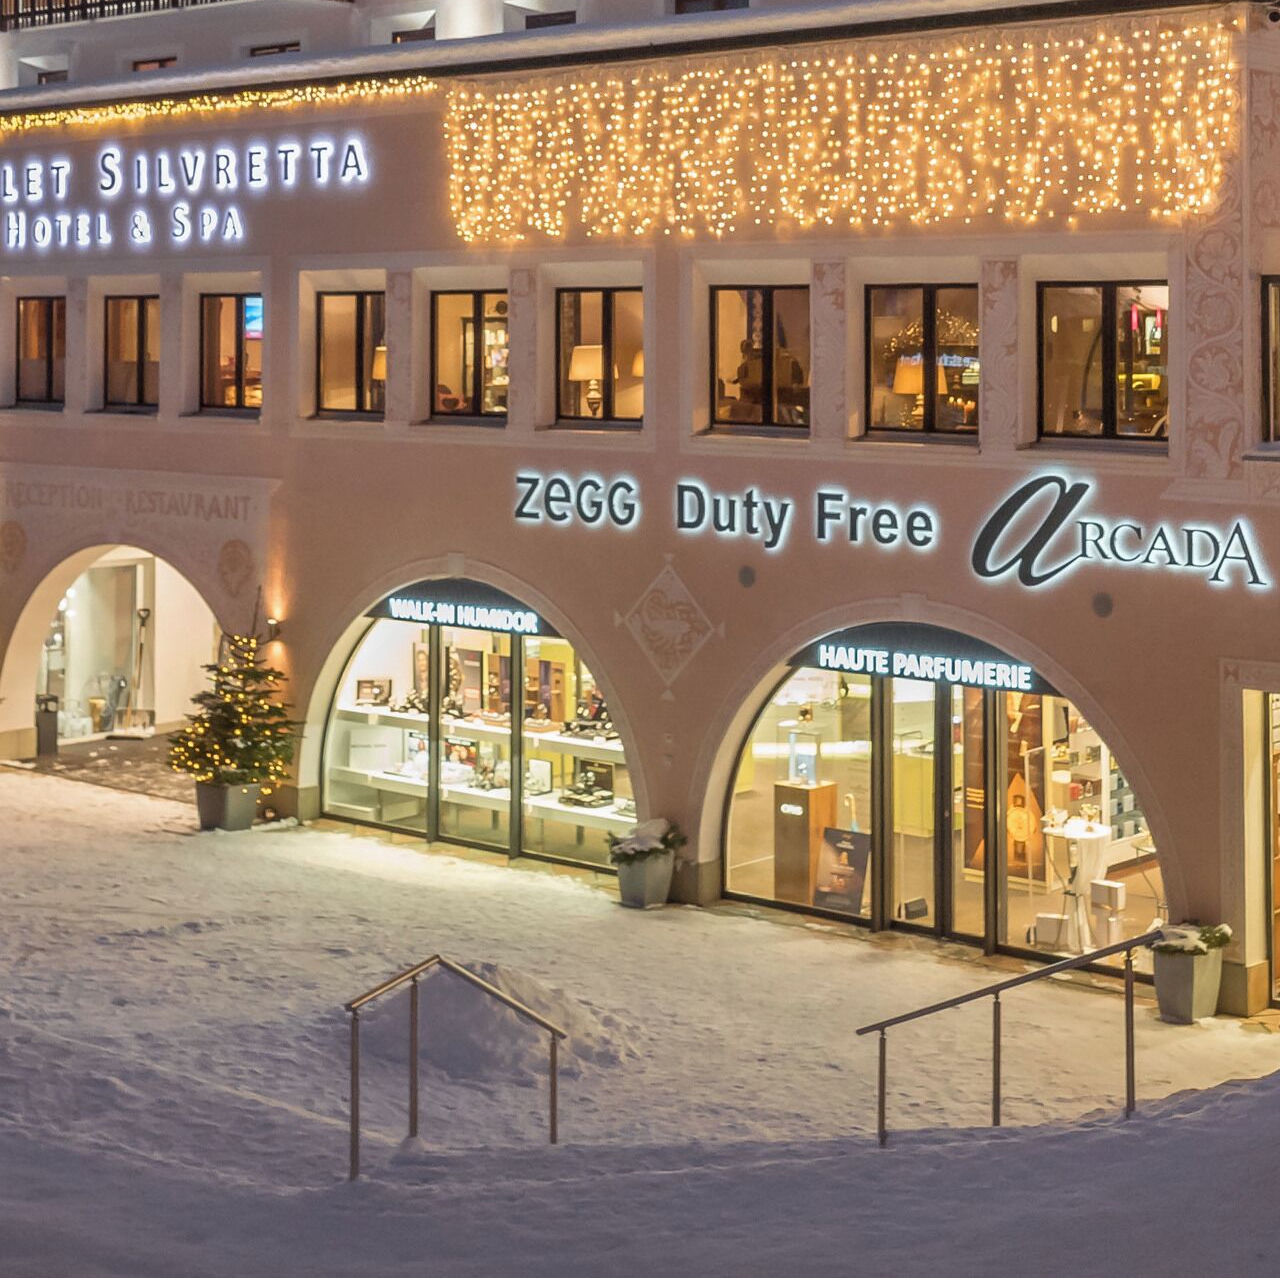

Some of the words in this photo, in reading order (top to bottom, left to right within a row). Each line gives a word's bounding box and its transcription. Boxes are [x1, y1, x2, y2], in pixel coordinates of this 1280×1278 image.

[98, 138, 370, 198] SILVRETTA
[7, 211, 112, 248] HOTEL
[131, 212, 152, 243] &
[172, 202, 244, 240] SPA
[676, 483, 791, 549] Duty
[816, 492, 935, 547] Free
[390, 598, 455, 624] WALK-IN
[457, 605, 538, 633] HUMIDOR
[819, 644, 889, 674] HAUTE
[892, 653, 1032, 690] PARFUMERIE
